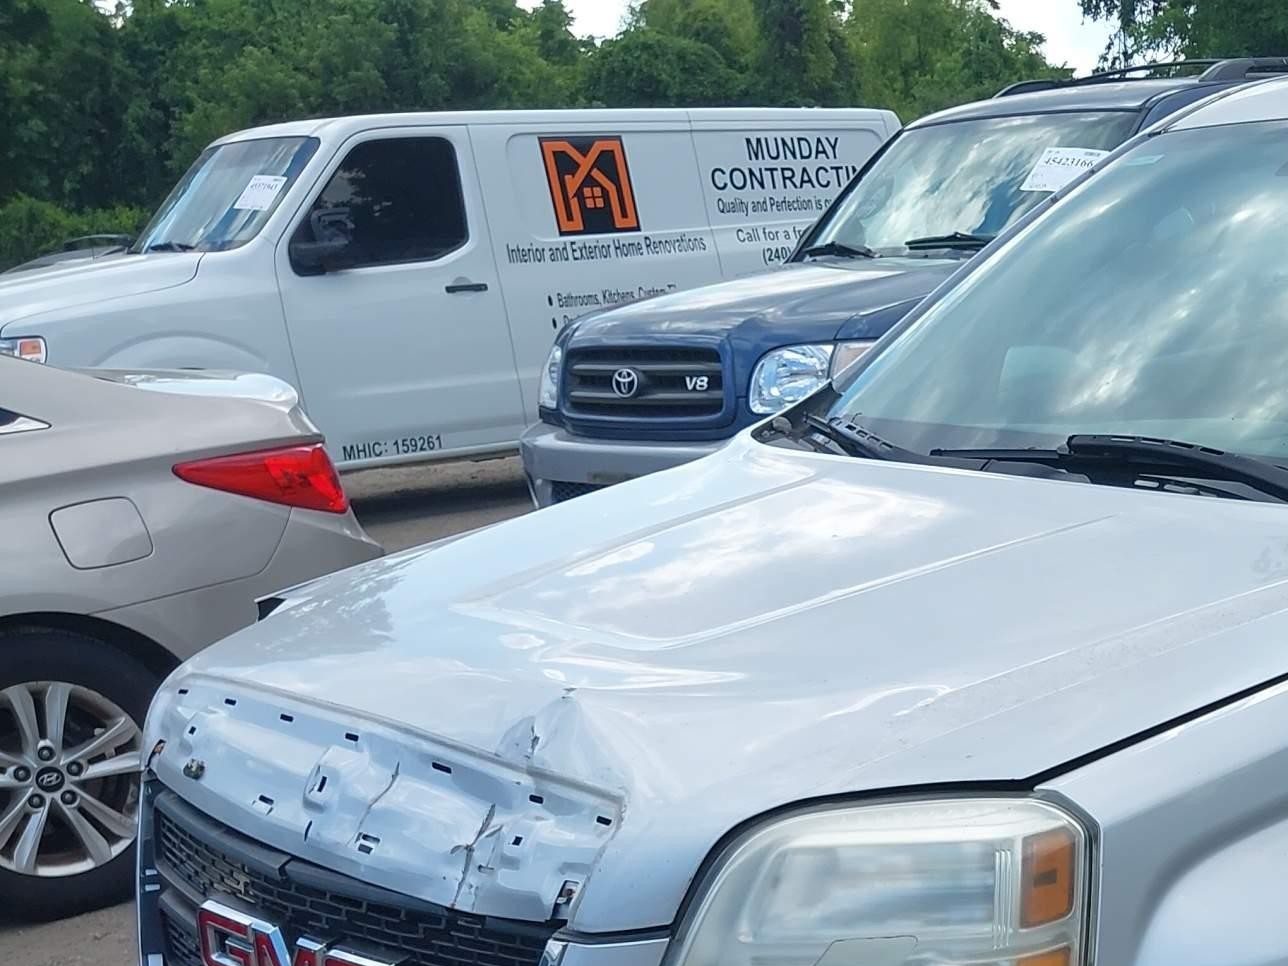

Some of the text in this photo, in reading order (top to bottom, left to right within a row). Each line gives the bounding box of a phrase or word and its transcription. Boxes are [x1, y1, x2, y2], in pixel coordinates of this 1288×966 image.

[745, 137, 839, 161] MUNDAY
[718, 197, 749, 216] Quality
[752, 197, 768, 212] and
[769, 196, 814, 212] Perfection
[815, 195, 823, 210] is
[736, 227, 760, 243] Call
[762, 227, 779, 241] for
[783, 230, 791, 240] a
[506, 235, 707, 264] Interior and Exterior Home Renovations
[685, 376, 709, 391] V8
[342, 435, 442, 461] MHIC: 159261
